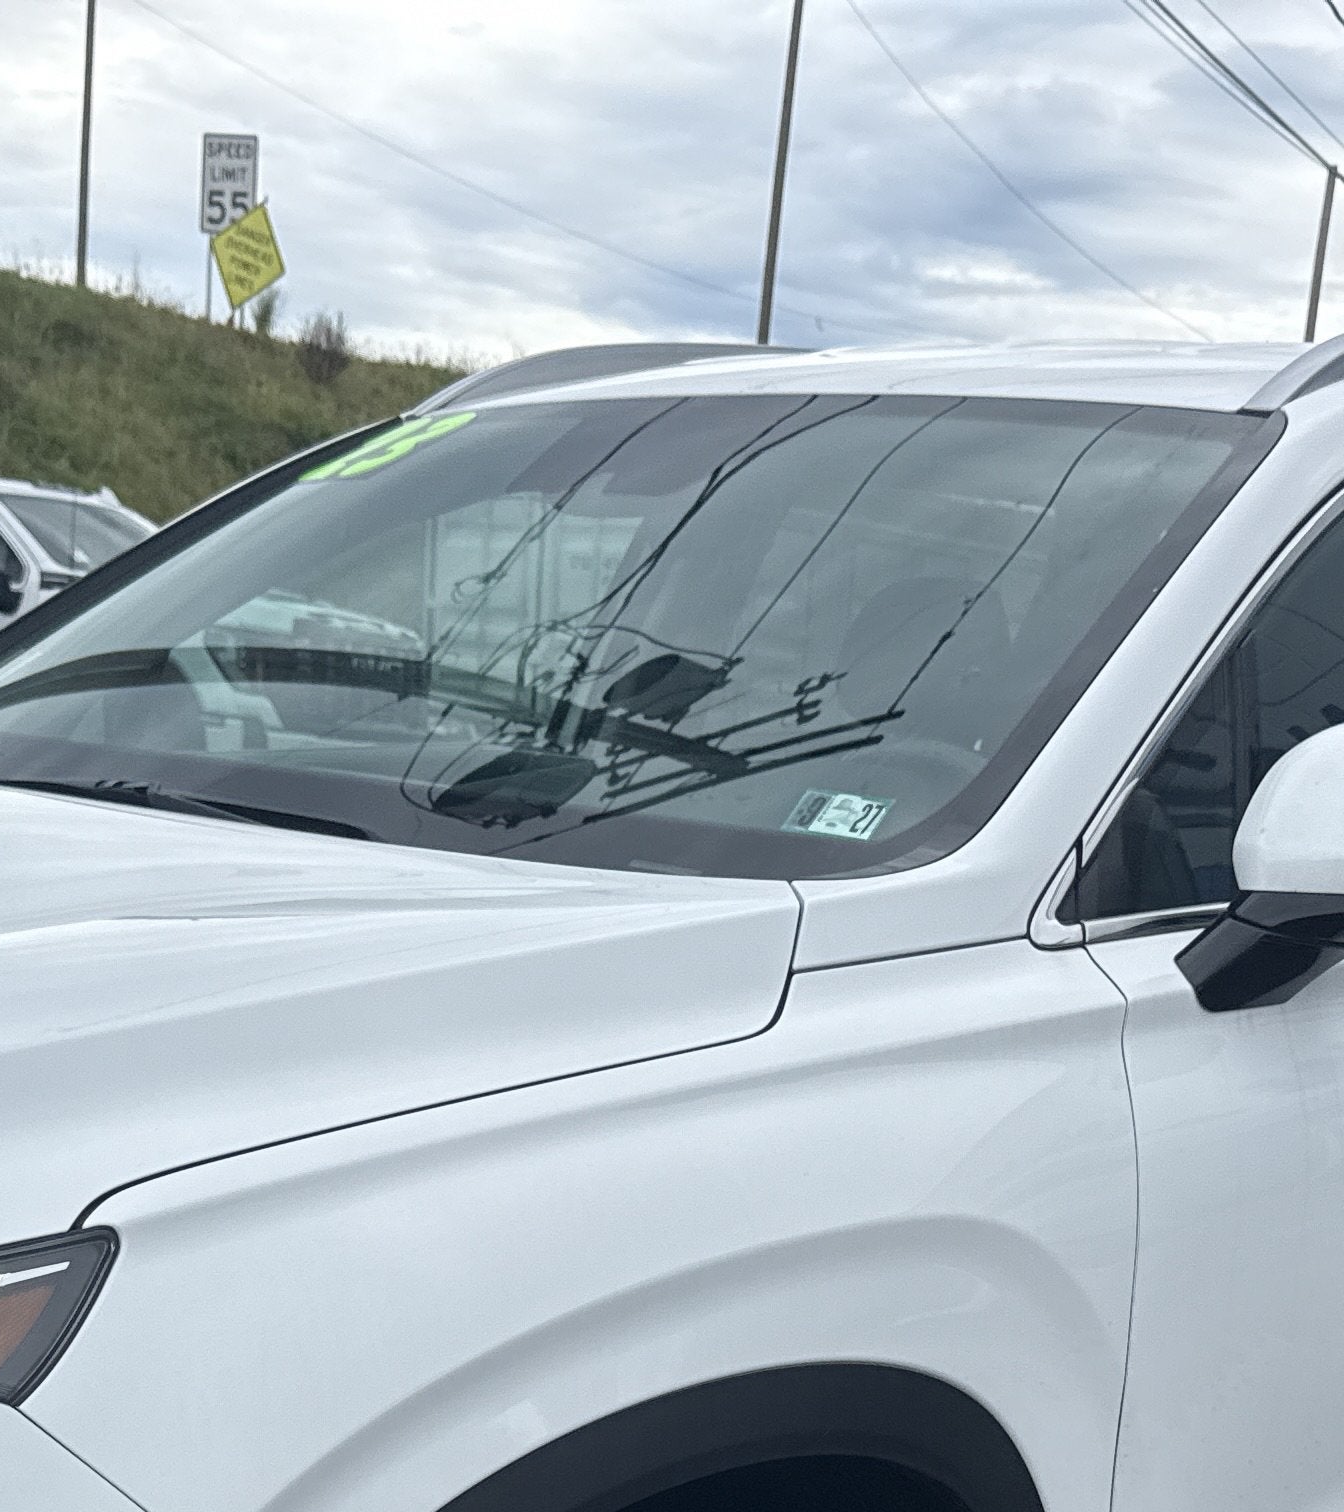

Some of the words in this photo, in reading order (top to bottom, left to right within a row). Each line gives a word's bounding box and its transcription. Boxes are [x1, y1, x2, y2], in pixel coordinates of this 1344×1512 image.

[207, 142, 255, 159] SPEED
[209, 166, 248, 183] LIMIT
[208, 190, 249, 224] 55
[849, 803, 886, 836] 27
